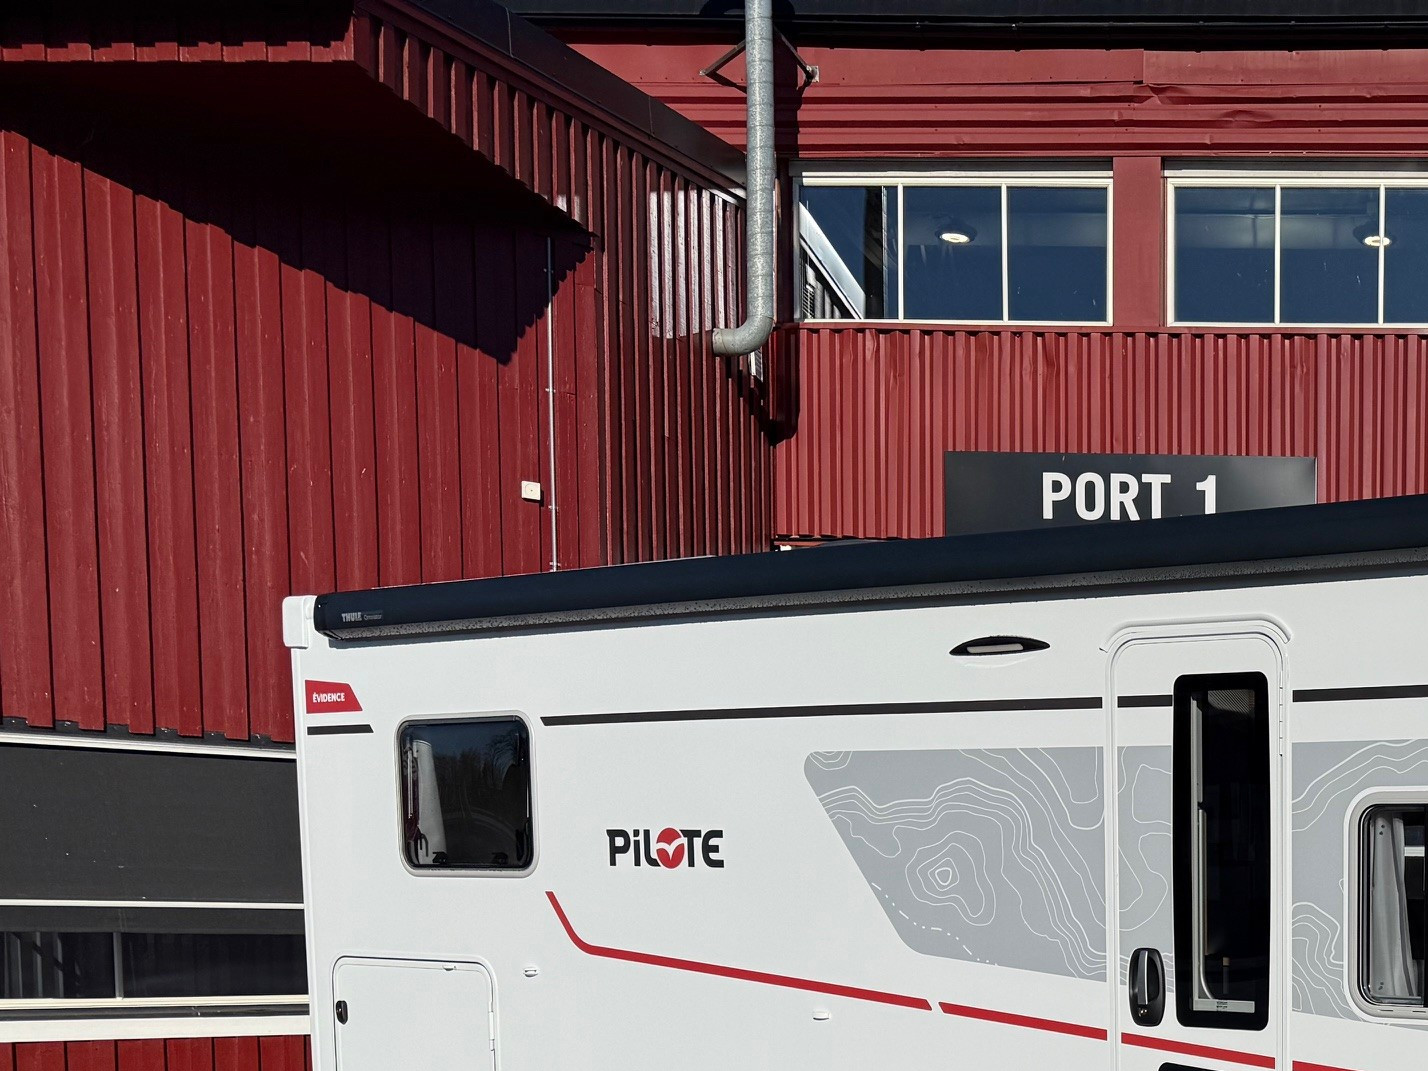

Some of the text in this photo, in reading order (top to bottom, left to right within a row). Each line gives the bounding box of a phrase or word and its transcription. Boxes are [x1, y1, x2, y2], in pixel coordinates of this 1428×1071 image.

[1042, 472, 1217, 521] PORT 1
[341, 612, 362, 622] THULE
[312, 692, 346, 703] ÉVIDENCE
